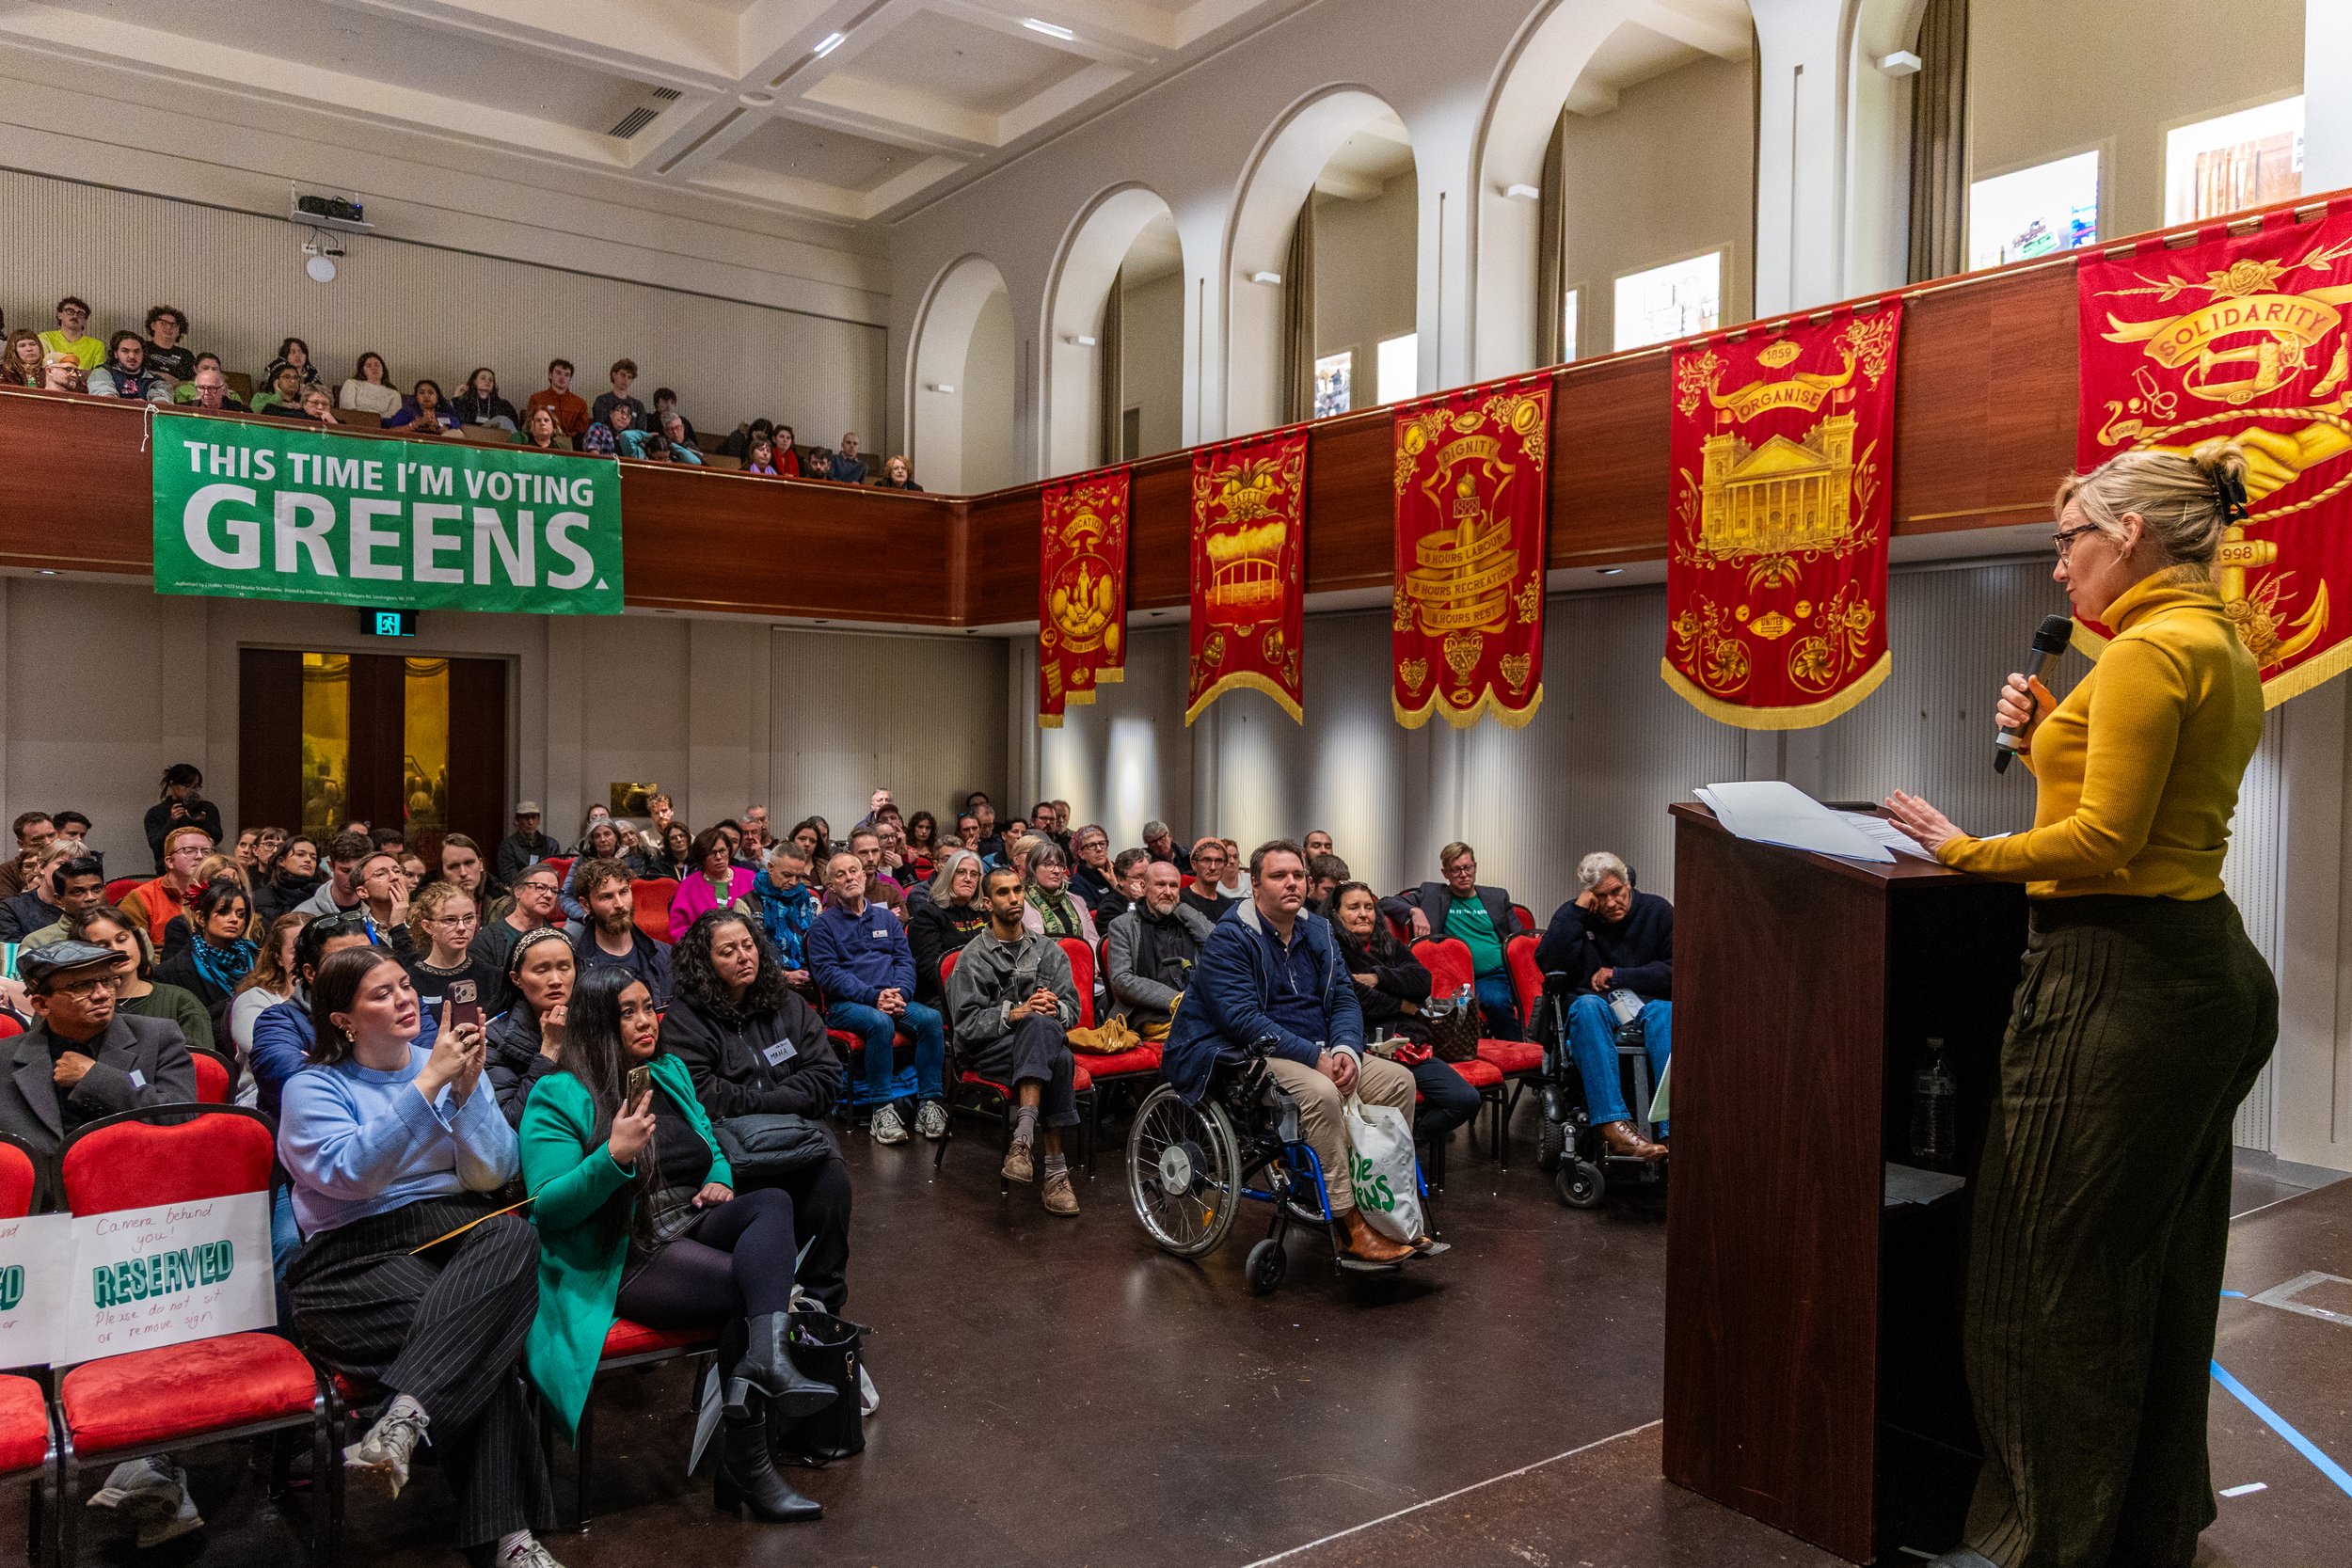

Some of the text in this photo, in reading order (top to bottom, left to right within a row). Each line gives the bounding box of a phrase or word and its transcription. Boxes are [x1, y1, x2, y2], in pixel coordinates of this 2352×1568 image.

[2159, 303, 2328, 356] SOLIDARITY
[1766, 347, 1792, 360] 1859
[1740, 388, 1821, 417] ORGANISE
[1442, 440, 1495, 463] DIGNITY
[183, 440, 595, 507] THIS TIME I'M VOTING
[1231, 490, 1265, 507] SAFETY
[1064, 516, 1105, 541] EDUCATION
[1424, 532, 1504, 563] 8 HOURS LABOUR
[2222, 546, 2252, 561] 998
[1413, 562, 1514, 595] 8 HOURS RECREATION
[1432, 605, 1497, 624] 8 HOURS REST
[1760, 616, 1784, 626] UNITED
[96, 1203, 213, 1236] Camera behind
[92, 1240, 234, 1308] RESERVED
[95, 1289, 222, 1327] Please do not sit
[3, 1320, 19, 1330] or
[98, 1310, 213, 1343] or remove sign
